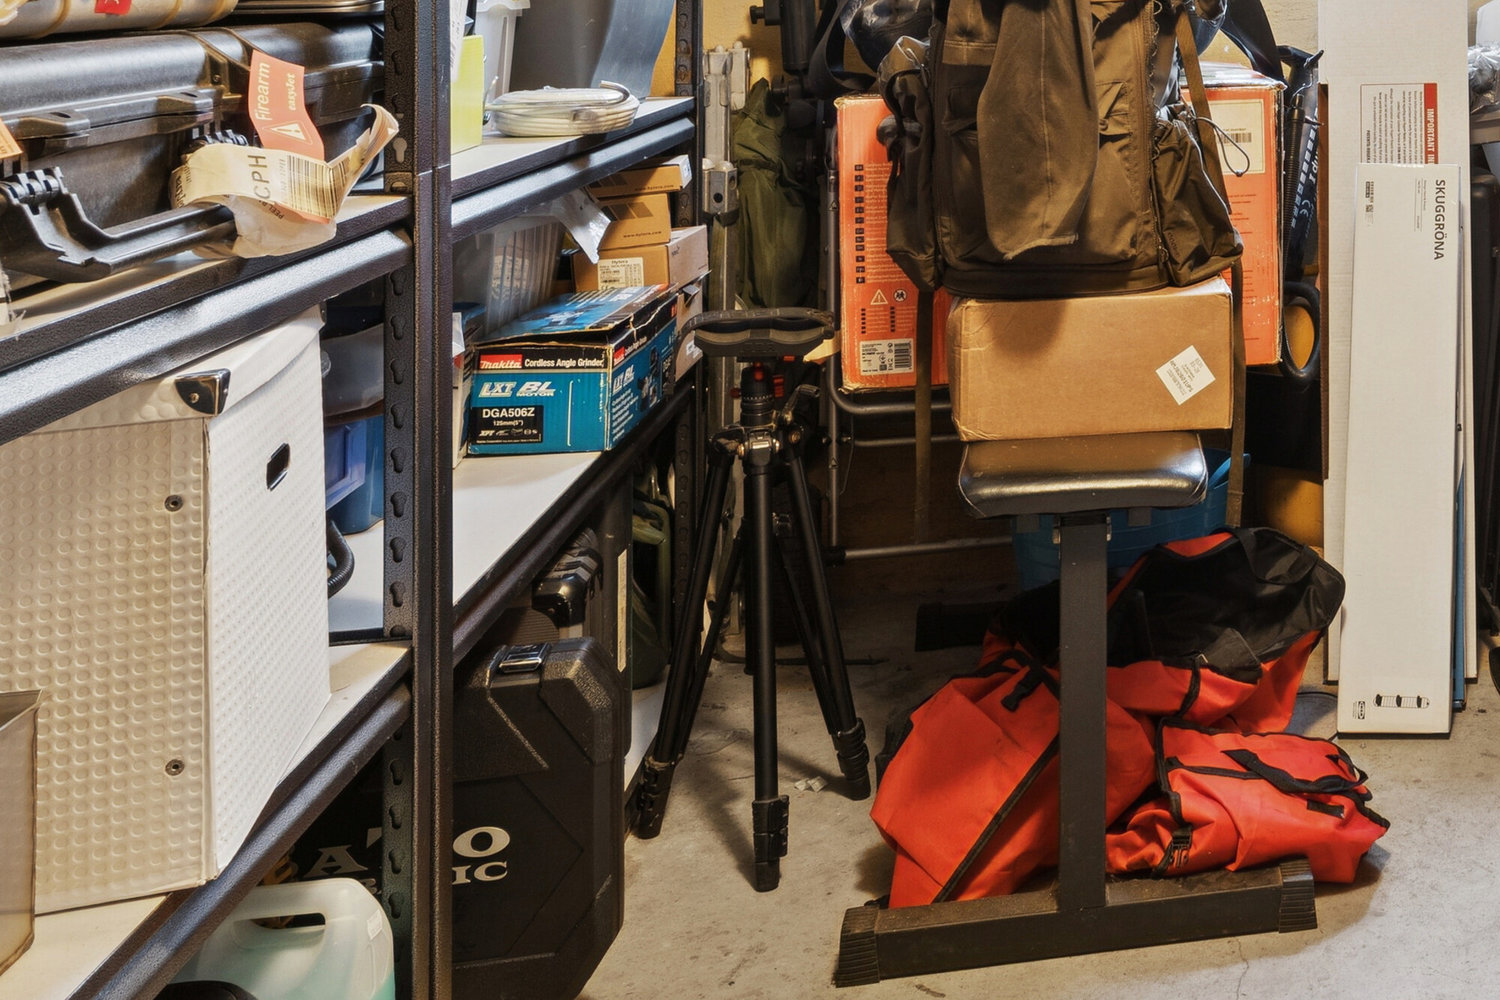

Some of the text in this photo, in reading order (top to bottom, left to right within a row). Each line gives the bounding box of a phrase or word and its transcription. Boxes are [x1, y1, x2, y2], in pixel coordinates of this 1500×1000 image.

[255, 61, 273, 121] Firearm
[288, 72, 296, 111] easyJet
[1426, 108, 1435, 152] IMPORTANT
[247, 154, 273, 200] CPH
[1433, 179, 1448, 261] SKUGGRÖNA
[479, 359, 522, 369] makita
[524, 358, 555, 368] Cordless
[556, 358, 577, 369] Angle
[479, 381, 556, 398] LXT BL
[482, 407, 535, 418] DGA506Z
